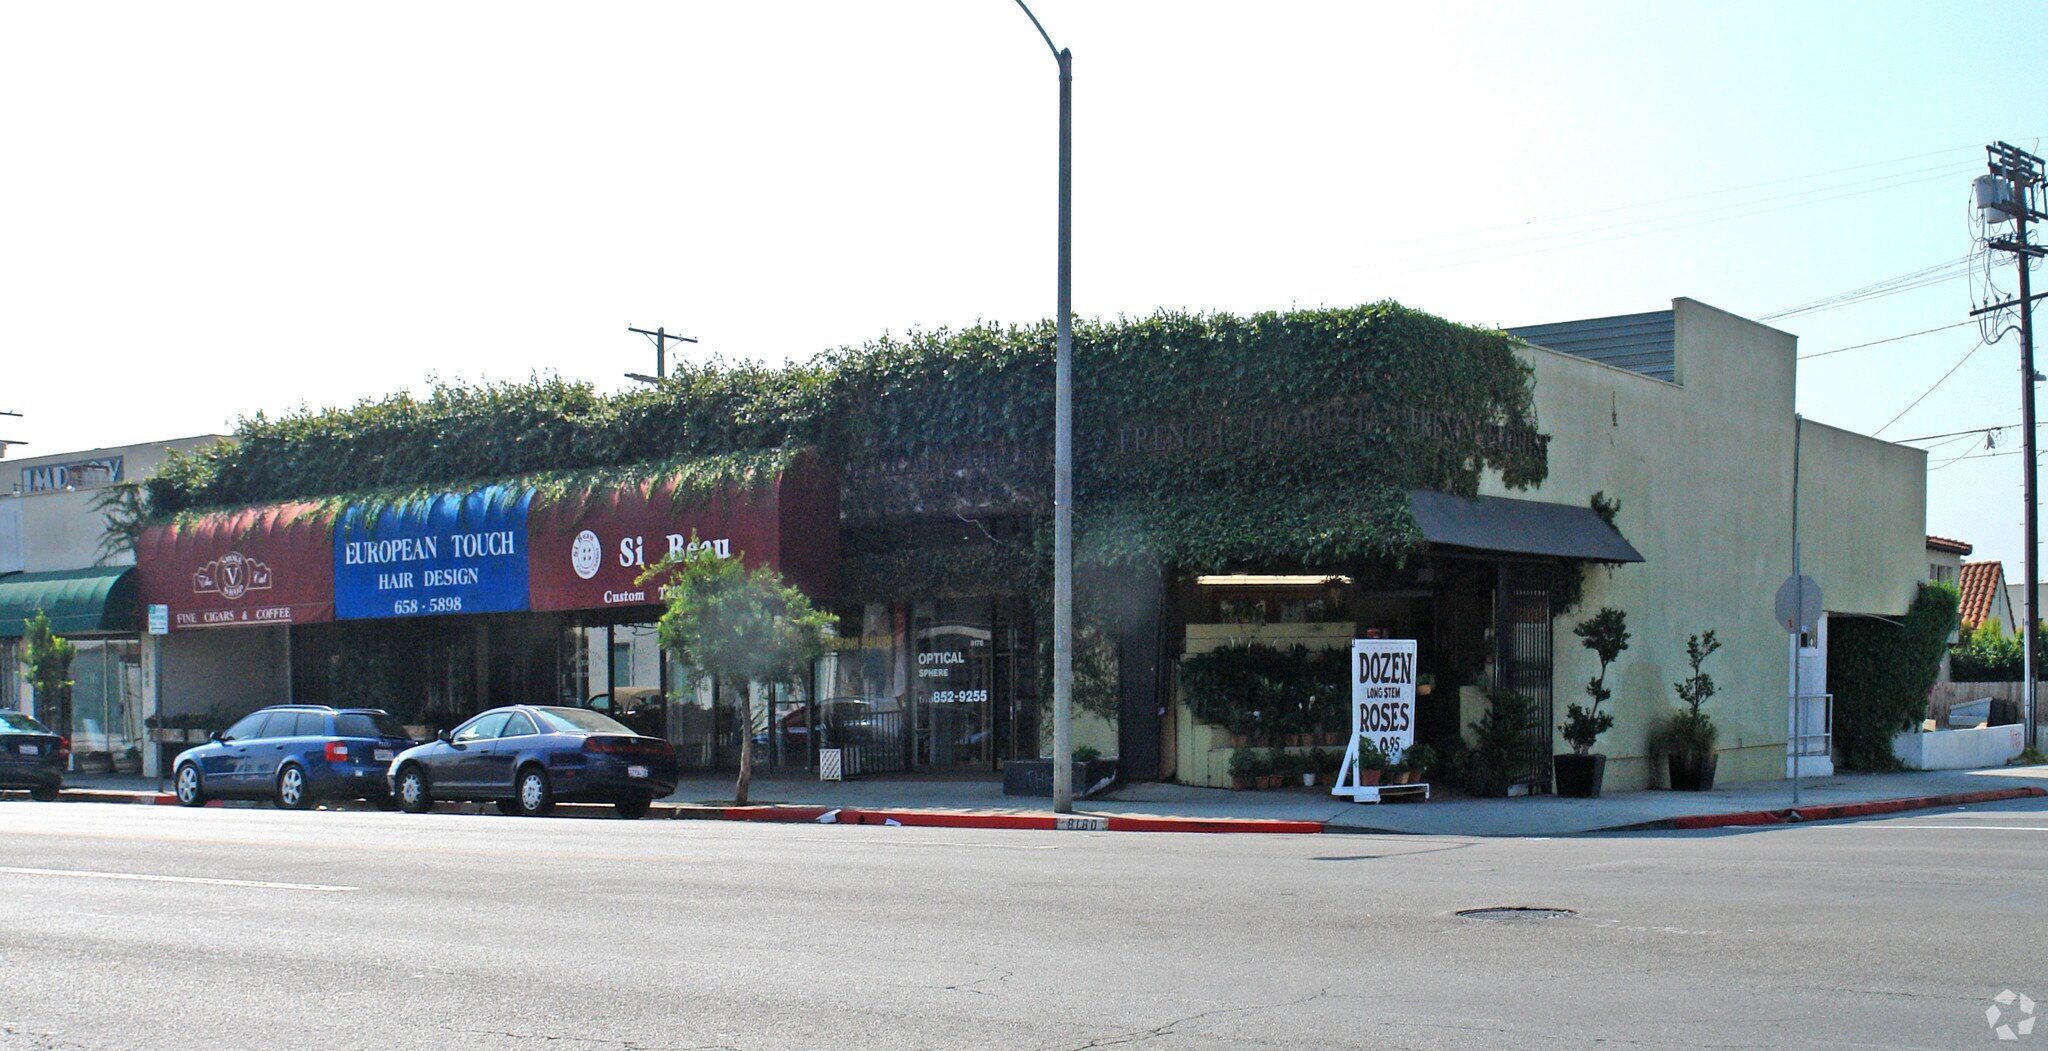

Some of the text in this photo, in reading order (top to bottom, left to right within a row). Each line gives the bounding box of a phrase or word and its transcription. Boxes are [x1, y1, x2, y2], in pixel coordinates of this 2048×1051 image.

[345, 531, 515, 565] EUROPEAN TOUCH
[619, 535, 645, 567] Si
[666, 533, 731, 564] Beau
[226, 567, 239, 585] V
[378, 567, 479, 590] HAIR DESIGN
[224, 584, 244, 597] SHOP
[603, 590, 646, 604] Custom
[394, 596, 462, 615] 658 5898
[176, 613, 198, 624] FINE
[204, 610, 235, 623] CIGARS
[256, 607, 292, 621] COFFEE
[918, 652, 964, 664] OPTICAL
[918, 668, 949, 678] SPHERE
[1359, 652, 1412, 684] DOZEN
[1367, 687, 1401, 698] LONG STEM
[1360, 702, 1410, 732] ROSES
[1067, 818, 1097, 831] 8180
